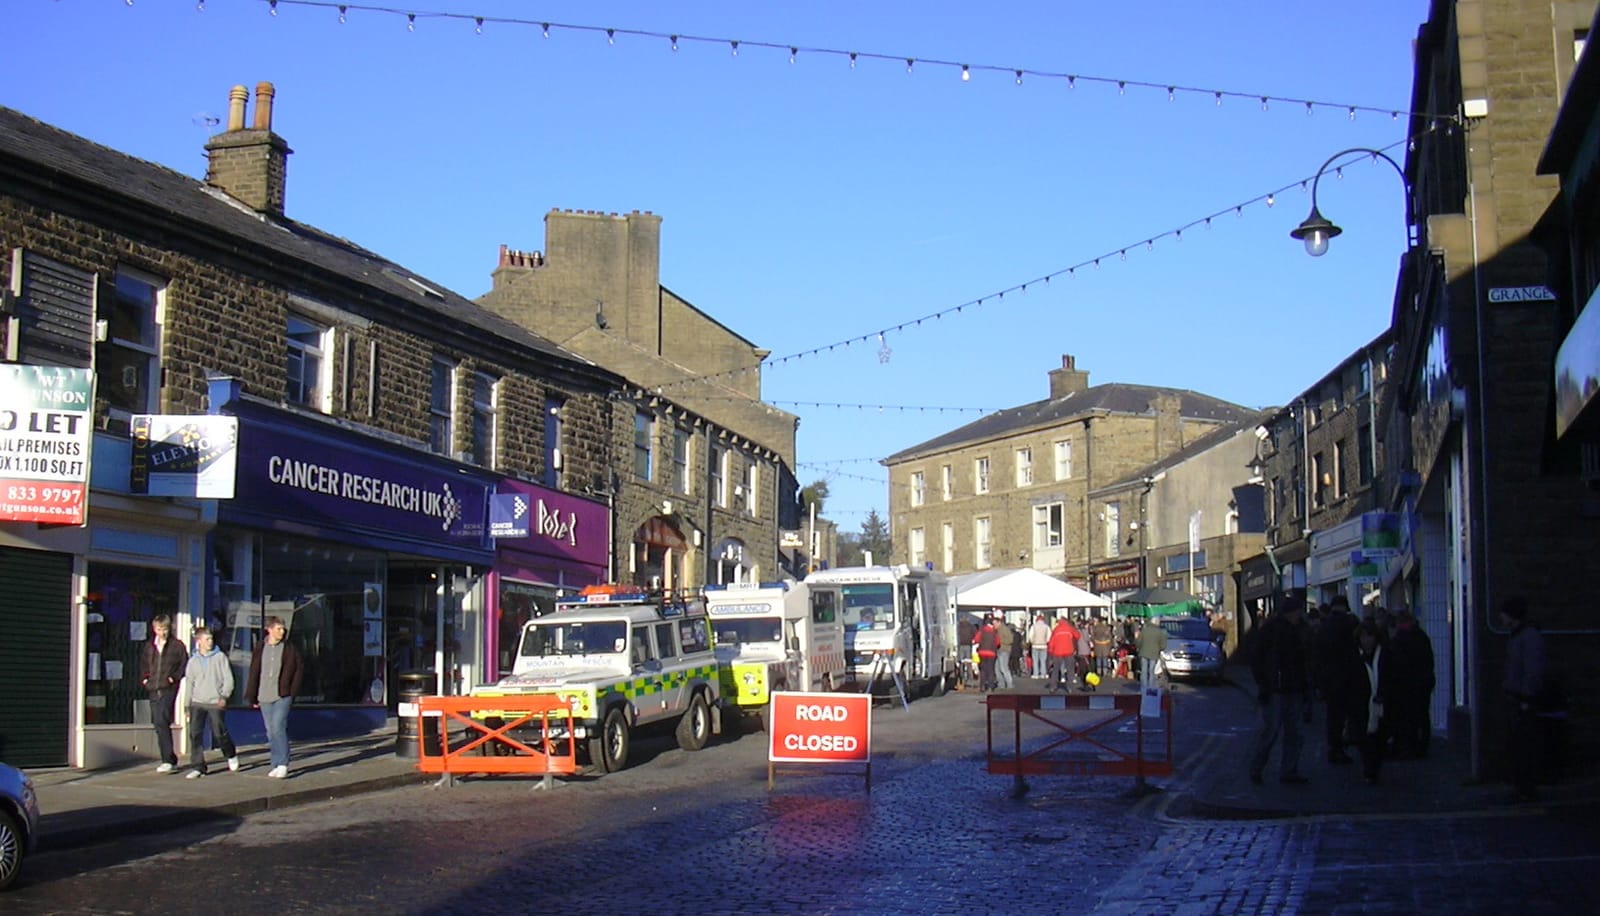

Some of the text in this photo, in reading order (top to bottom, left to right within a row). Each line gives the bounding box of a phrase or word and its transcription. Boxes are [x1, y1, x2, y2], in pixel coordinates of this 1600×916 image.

[1490, 288, 1551, 301] GRANGE
[28, 412, 83, 435] LET
[17, 439, 81, 456] PREMISES
[51, 459, 84, 476] SQ.FT
[8, 486, 81, 503] 833 9797
[268, 456, 442, 517] CANCER RESEARCH UK
[0, 503, 80, 516] tgunson.co.uk
[714, 604, 767, 614] AMBULANCE
[526, 660, 565, 668] MOUNTAIN
[795, 704, 848, 721] ROAD
[784, 734, 858, 752] CLOSED
